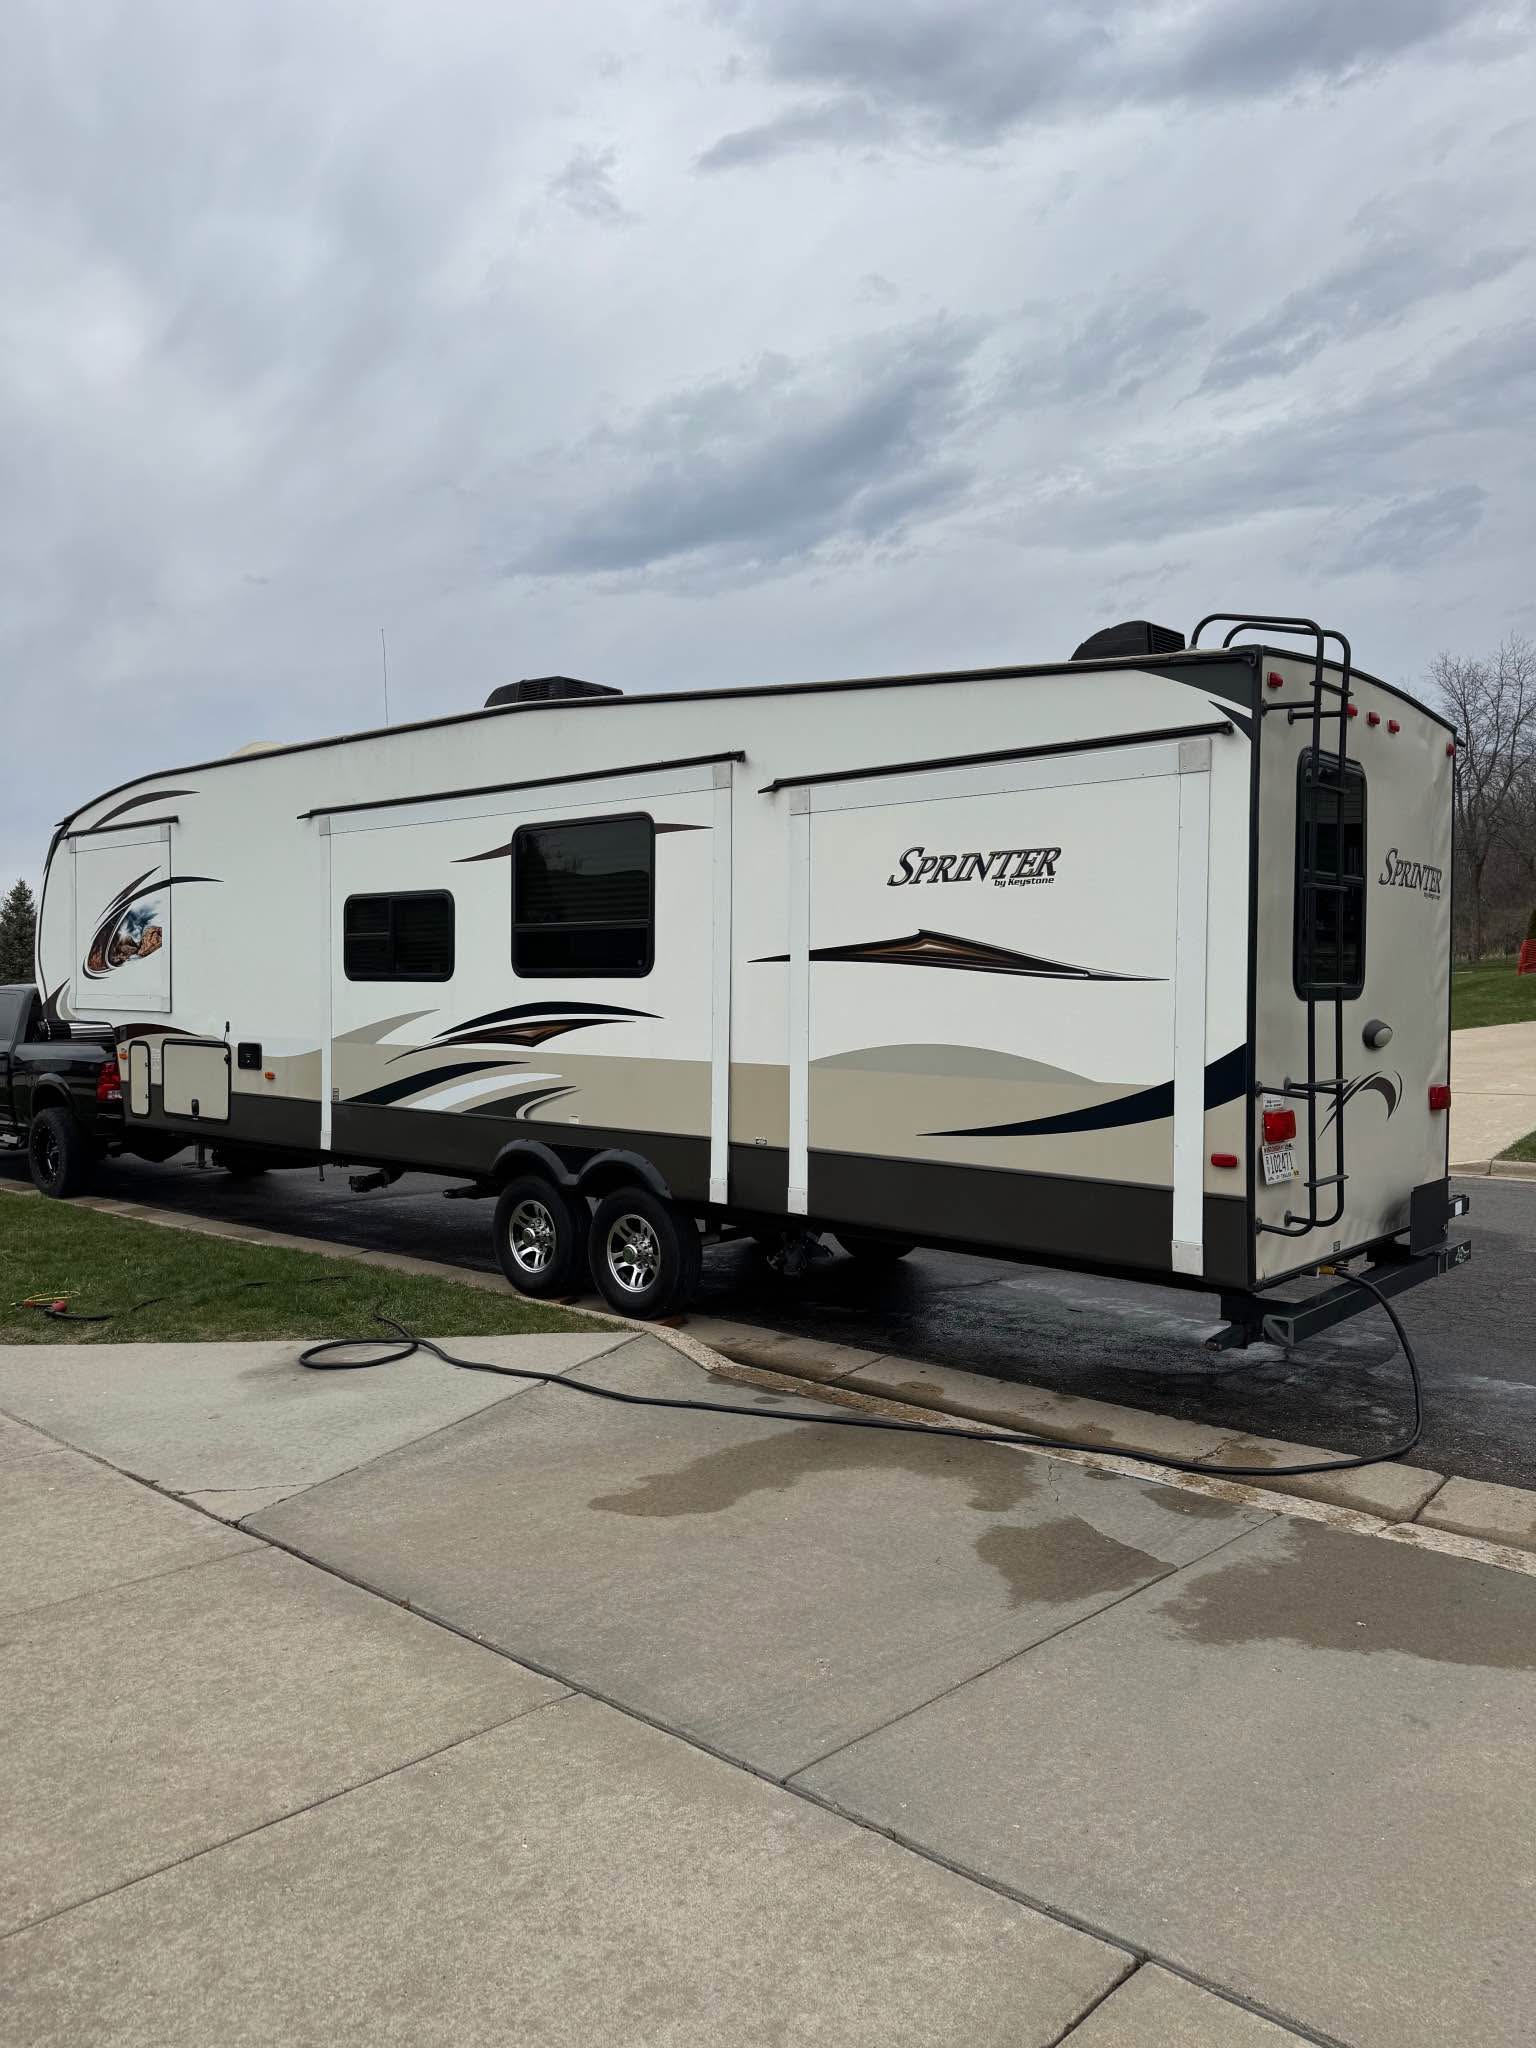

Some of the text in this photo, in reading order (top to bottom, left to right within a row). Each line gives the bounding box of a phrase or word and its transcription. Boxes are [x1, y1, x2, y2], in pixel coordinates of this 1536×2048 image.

[887, 847, 1061, 886] SPRINTER
[1378, 848, 1442, 893] SPRINTER
[994, 877, 1055, 887] by Keystone
[1270, 1152, 1293, 1174] 102471
